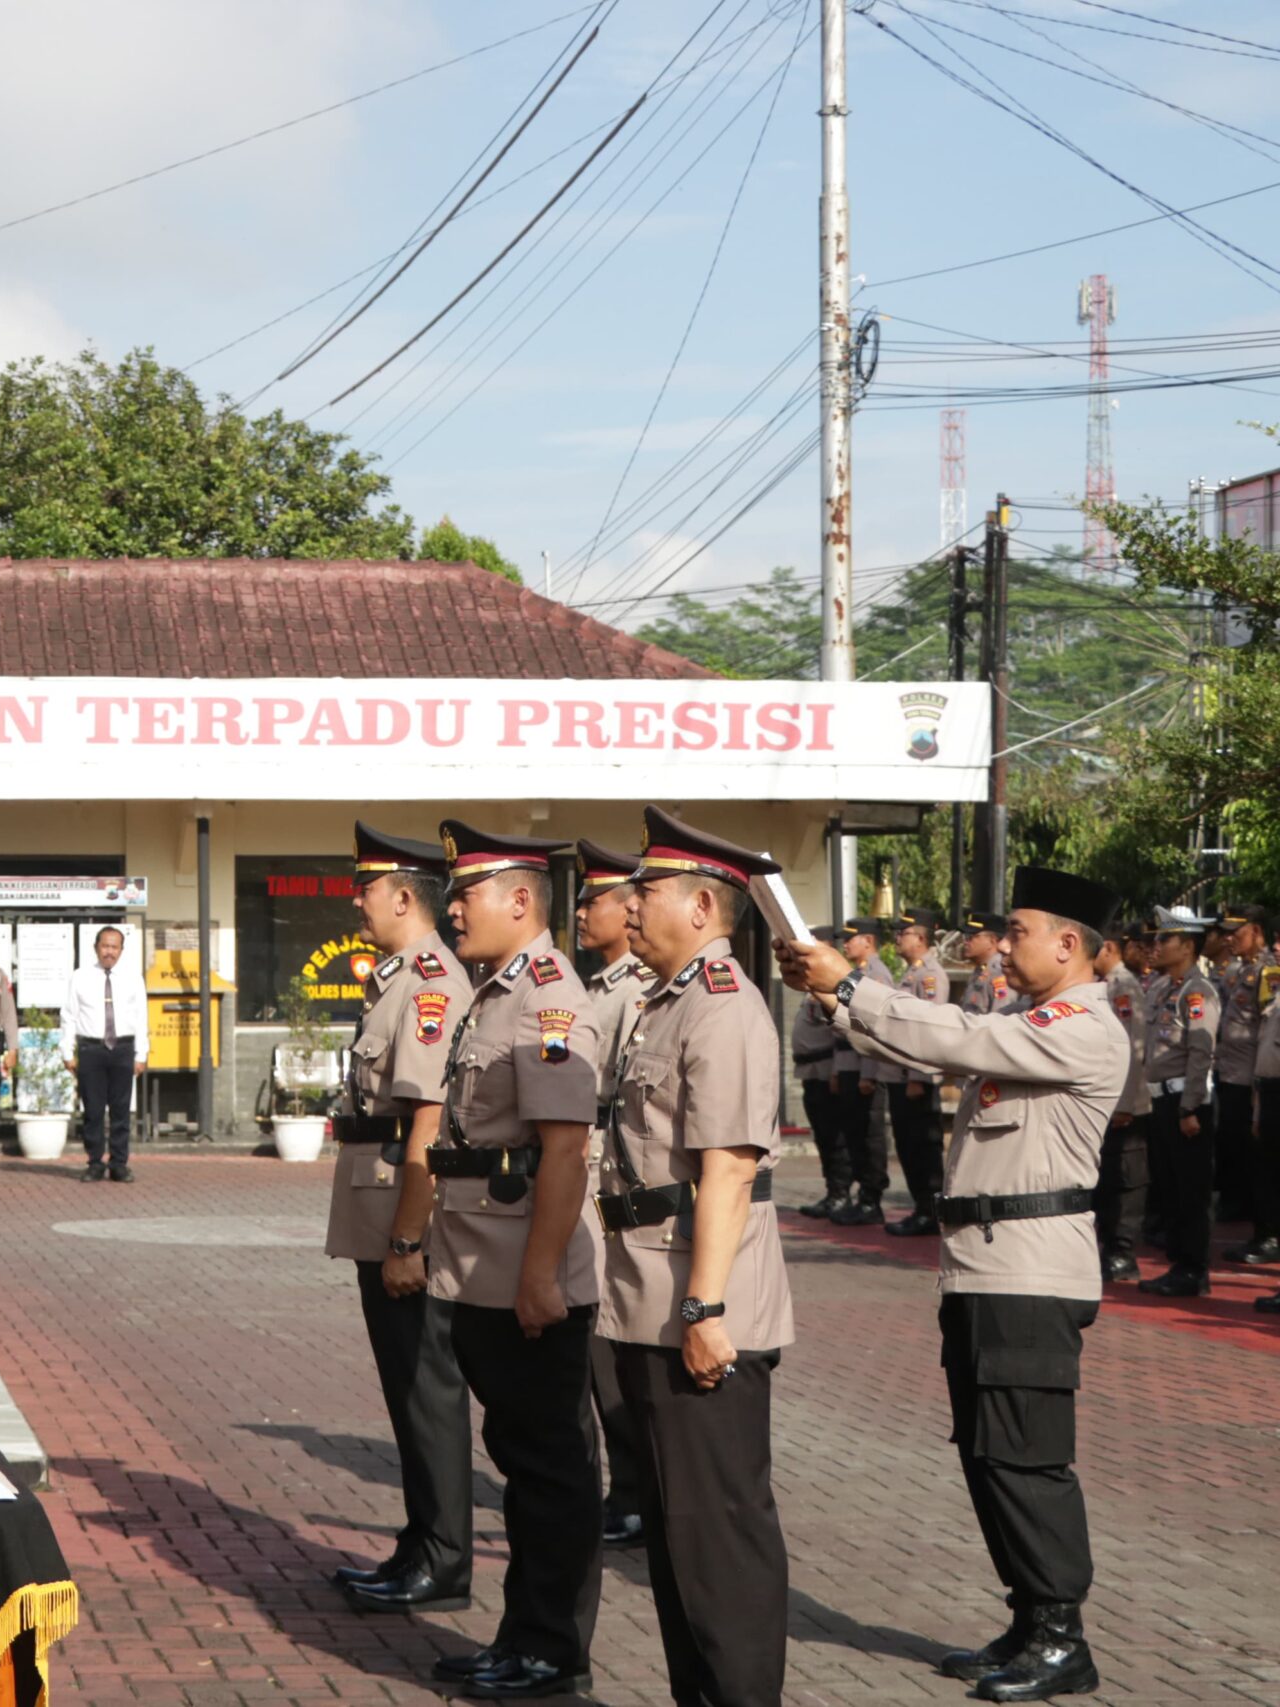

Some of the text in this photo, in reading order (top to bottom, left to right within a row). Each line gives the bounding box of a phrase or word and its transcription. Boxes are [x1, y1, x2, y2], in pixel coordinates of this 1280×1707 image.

[76, 697, 470, 747] TERPADU
[496, 701, 835, 751] PRESISI
[266, 876, 363, 896] TAMU WA
[161, 971, 201, 979] POLR
